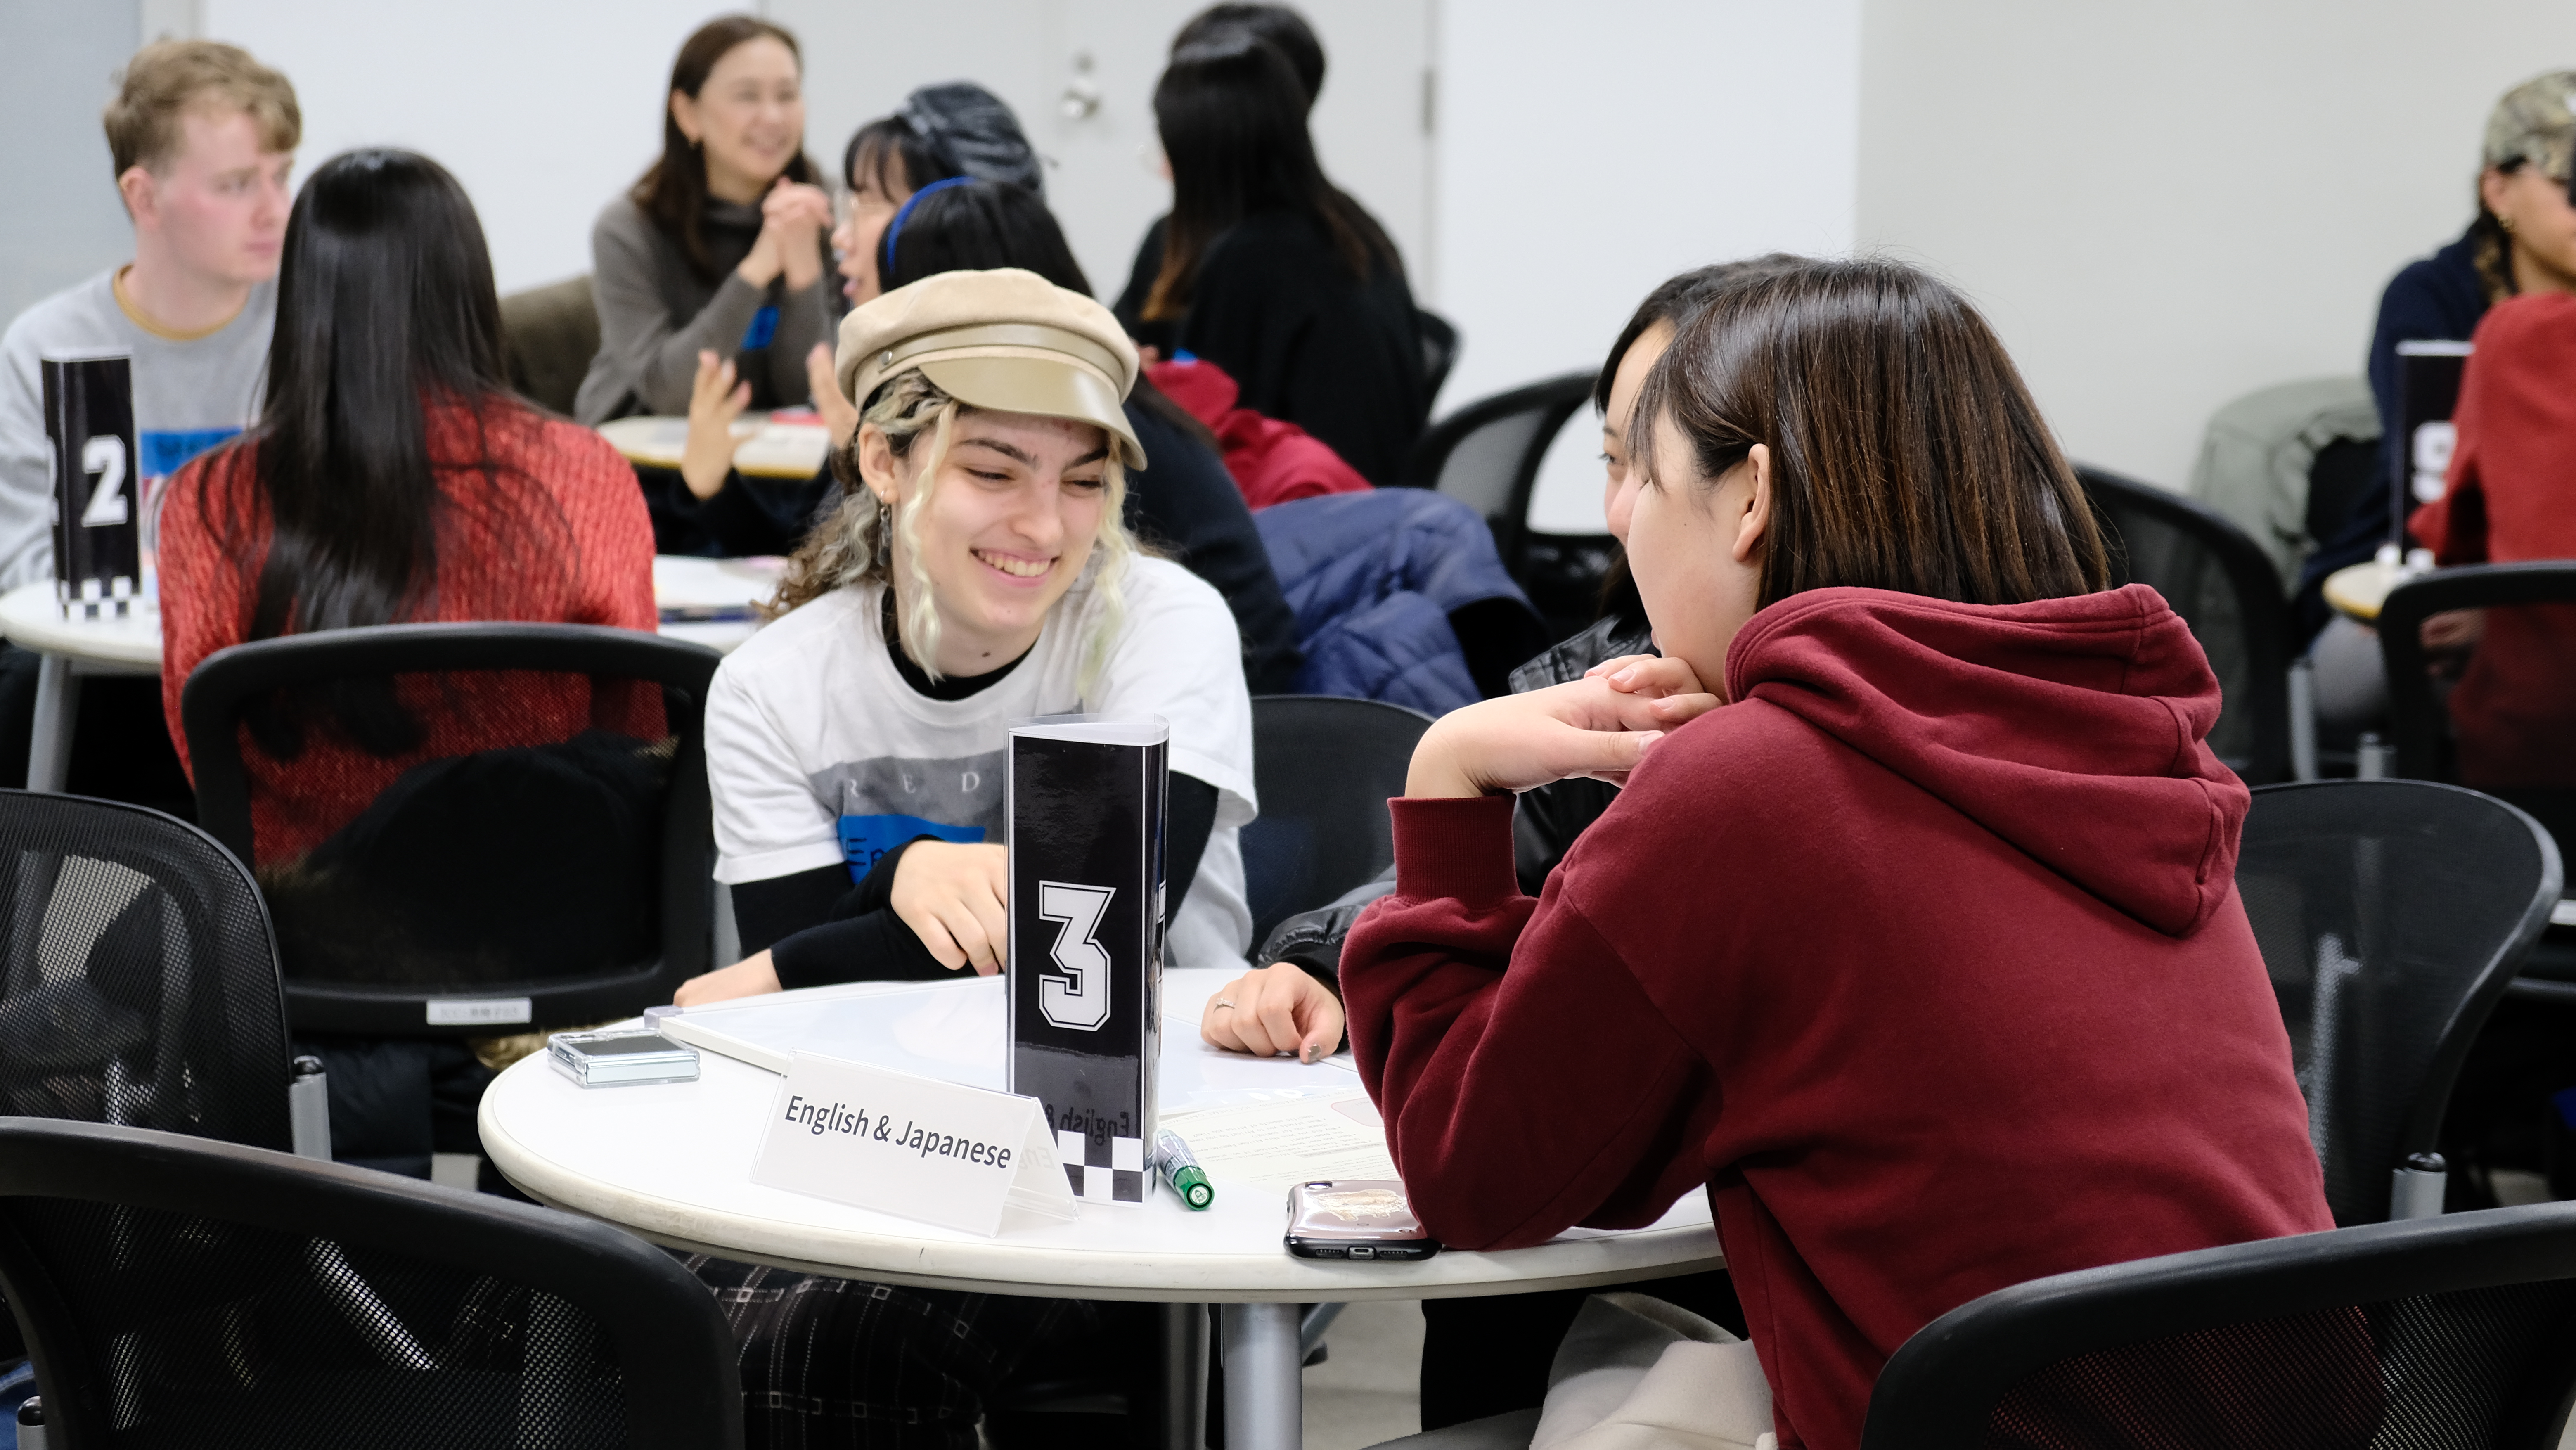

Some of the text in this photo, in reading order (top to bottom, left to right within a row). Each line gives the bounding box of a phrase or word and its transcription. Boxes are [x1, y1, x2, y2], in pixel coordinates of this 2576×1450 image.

[81, 434, 128, 527] 2
[1039, 880, 1116, 1032] 3
[786, 1096, 868, 1137] English
[874, 1116, 892, 1142] &
[896, 1121, 1011, 1168] Japanese
